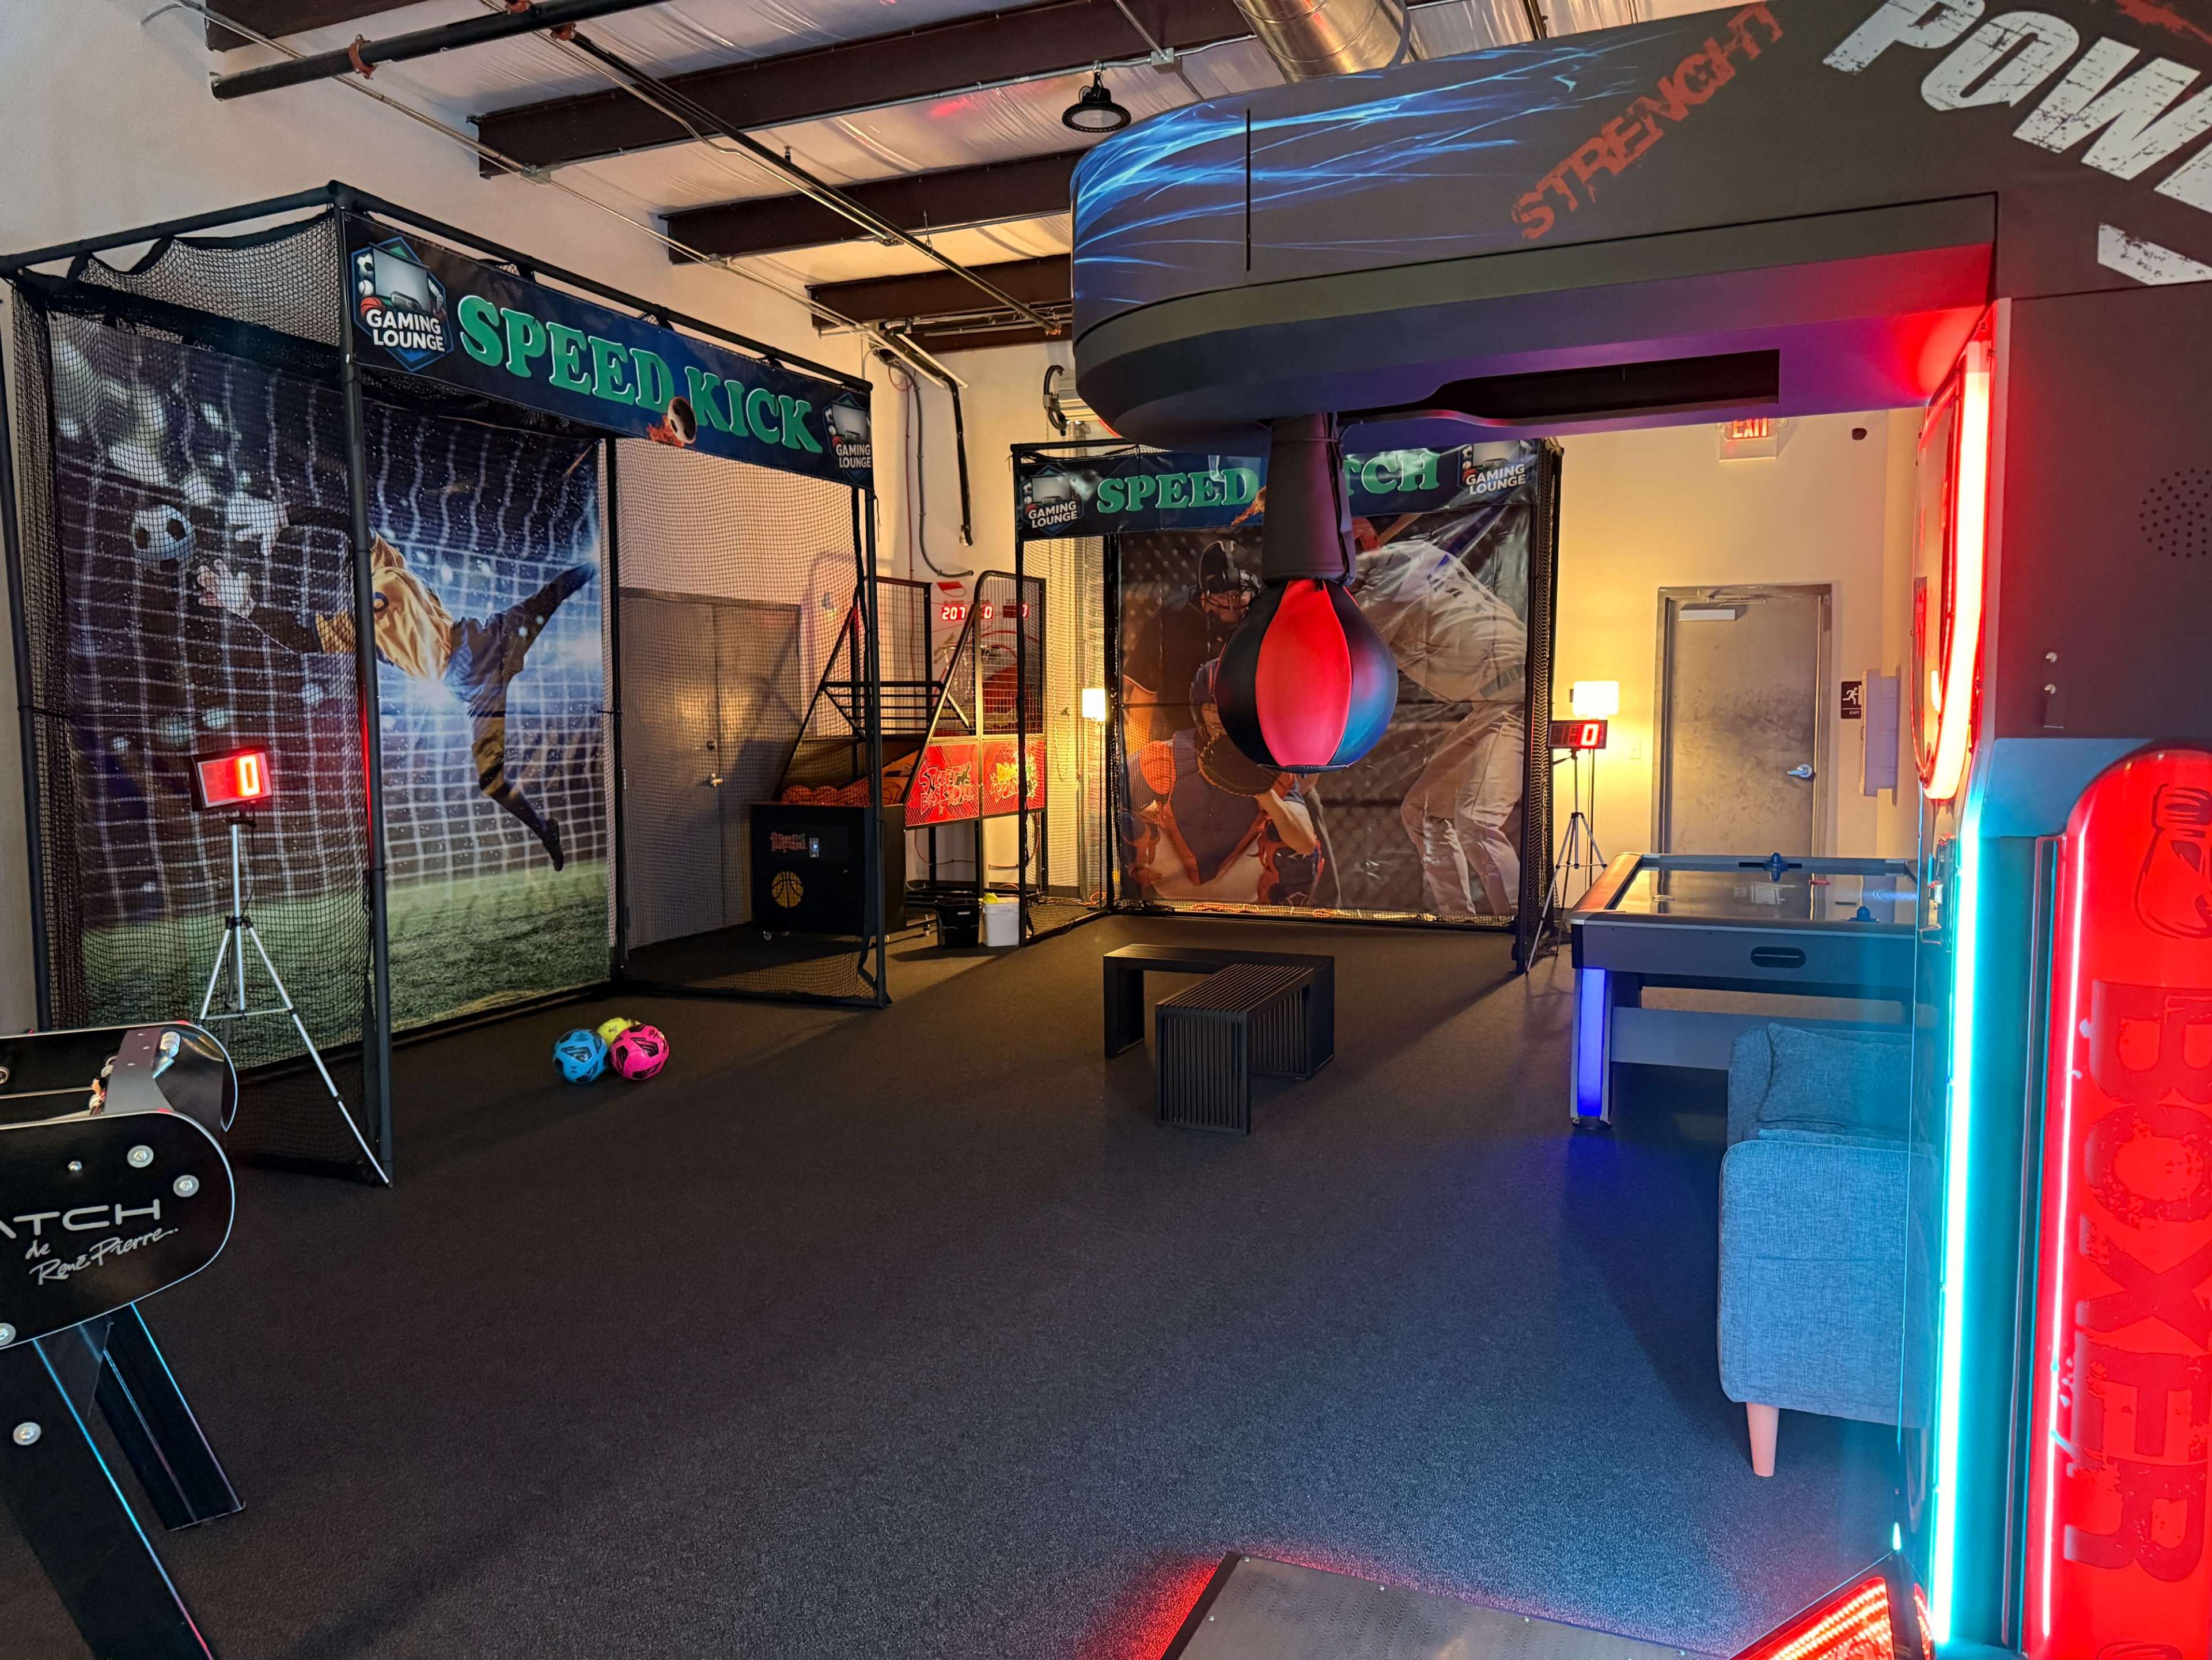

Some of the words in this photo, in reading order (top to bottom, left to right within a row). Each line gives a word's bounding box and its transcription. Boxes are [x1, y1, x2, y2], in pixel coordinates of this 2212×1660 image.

[366, 309, 441, 334] GAMING
[373, 329, 445, 352] LOUNGE
[457, 294, 675, 414] SPEED
[684, 366, 823, 453] KICK
[836, 443, 870, 456] GAMING
[839, 457, 872, 468] LOUNGE
[1465, 463, 1525, 486] GAMING
[1469, 474, 1526, 496] LOUNGE
[1097, 467, 1260, 513] SPEED
[1028, 501, 1077, 520] GAMING
[1032, 511, 1078, 529] LOUNGE
[942, 606, 966, 620] 207
[239, 755, 260, 796] 0
[25, 1240, 51, 1260] de
[2064, 980, 2212, 1583] BOXER
